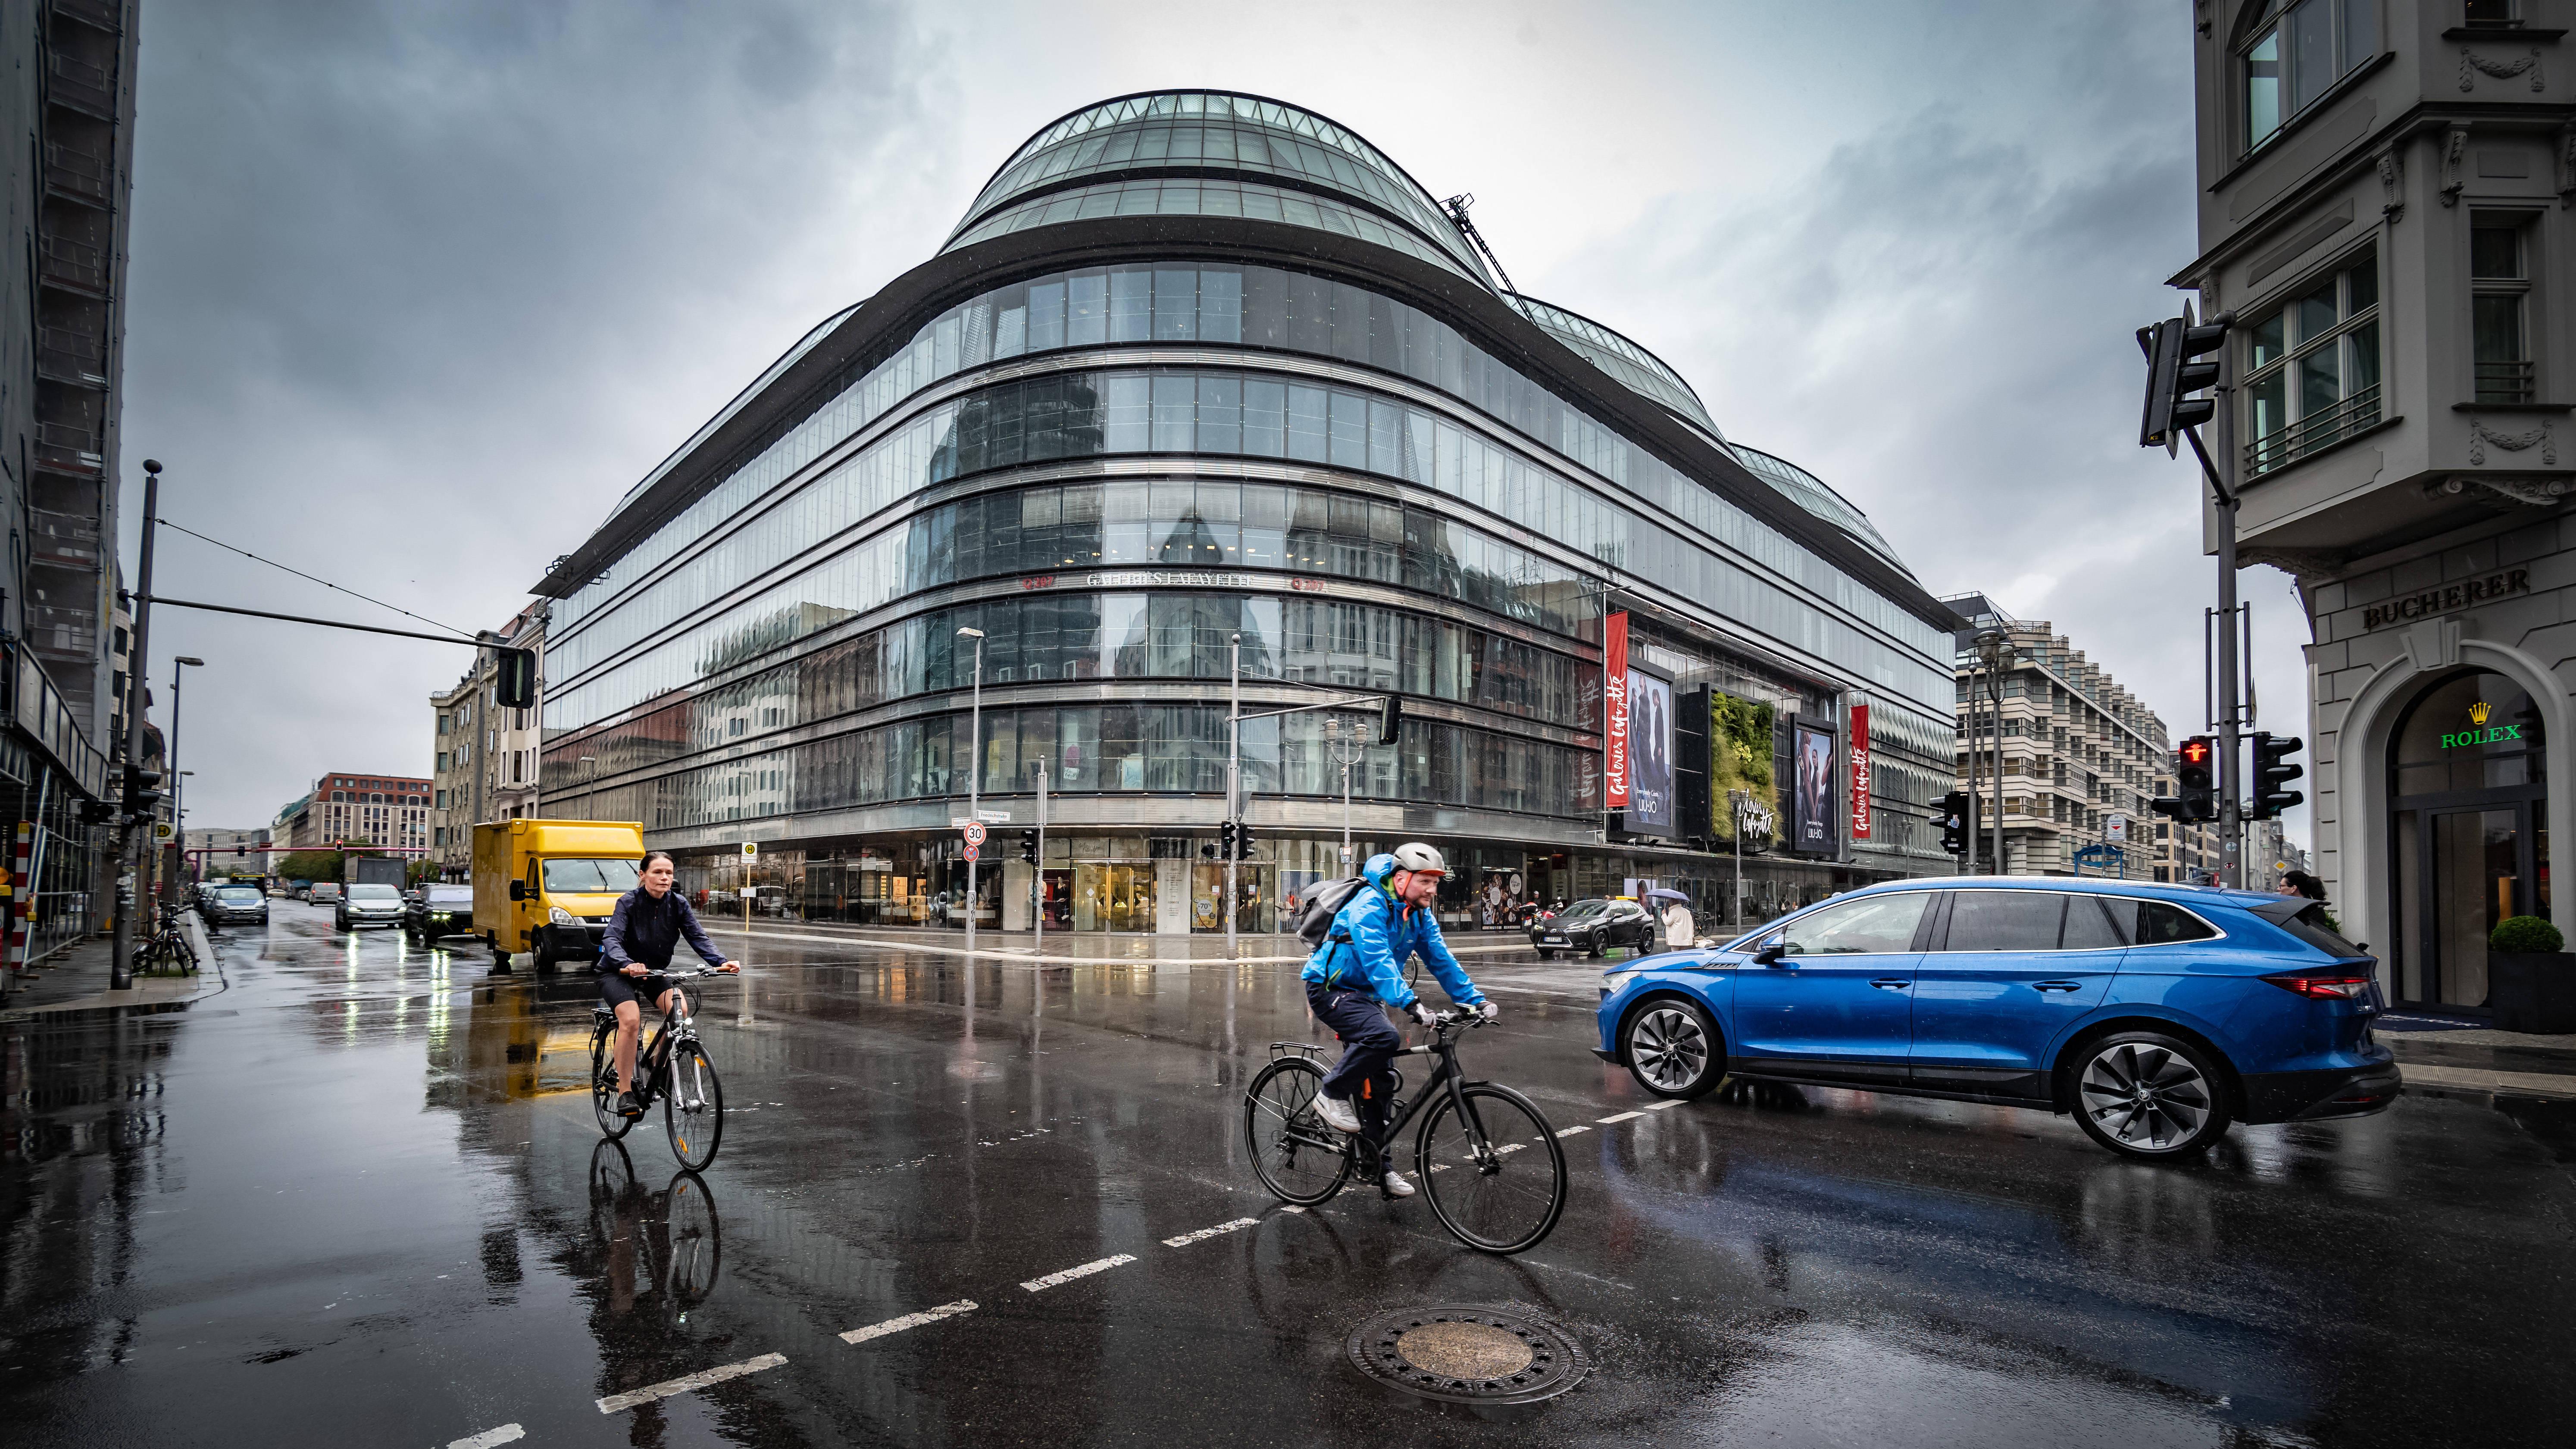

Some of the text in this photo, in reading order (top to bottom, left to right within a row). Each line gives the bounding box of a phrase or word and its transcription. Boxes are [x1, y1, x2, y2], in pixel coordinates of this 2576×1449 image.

[1087, 571, 1255, 587] GALERIES LAFAYETTE
[2362, 569, 2530, 629] BUCHERER
[1607, 671, 1629, 795] Galeries Lafayette
[2441, 725, 2522, 748] ROLEX
[1637, 787, 1651, 798] Everybody
[1738, 788, 1763, 816] leries
[1851, 746, 1870, 831] Galeries Lafayette
[969, 828, 982, 839] 30
[1743, 808, 1775, 839] Lafayette
